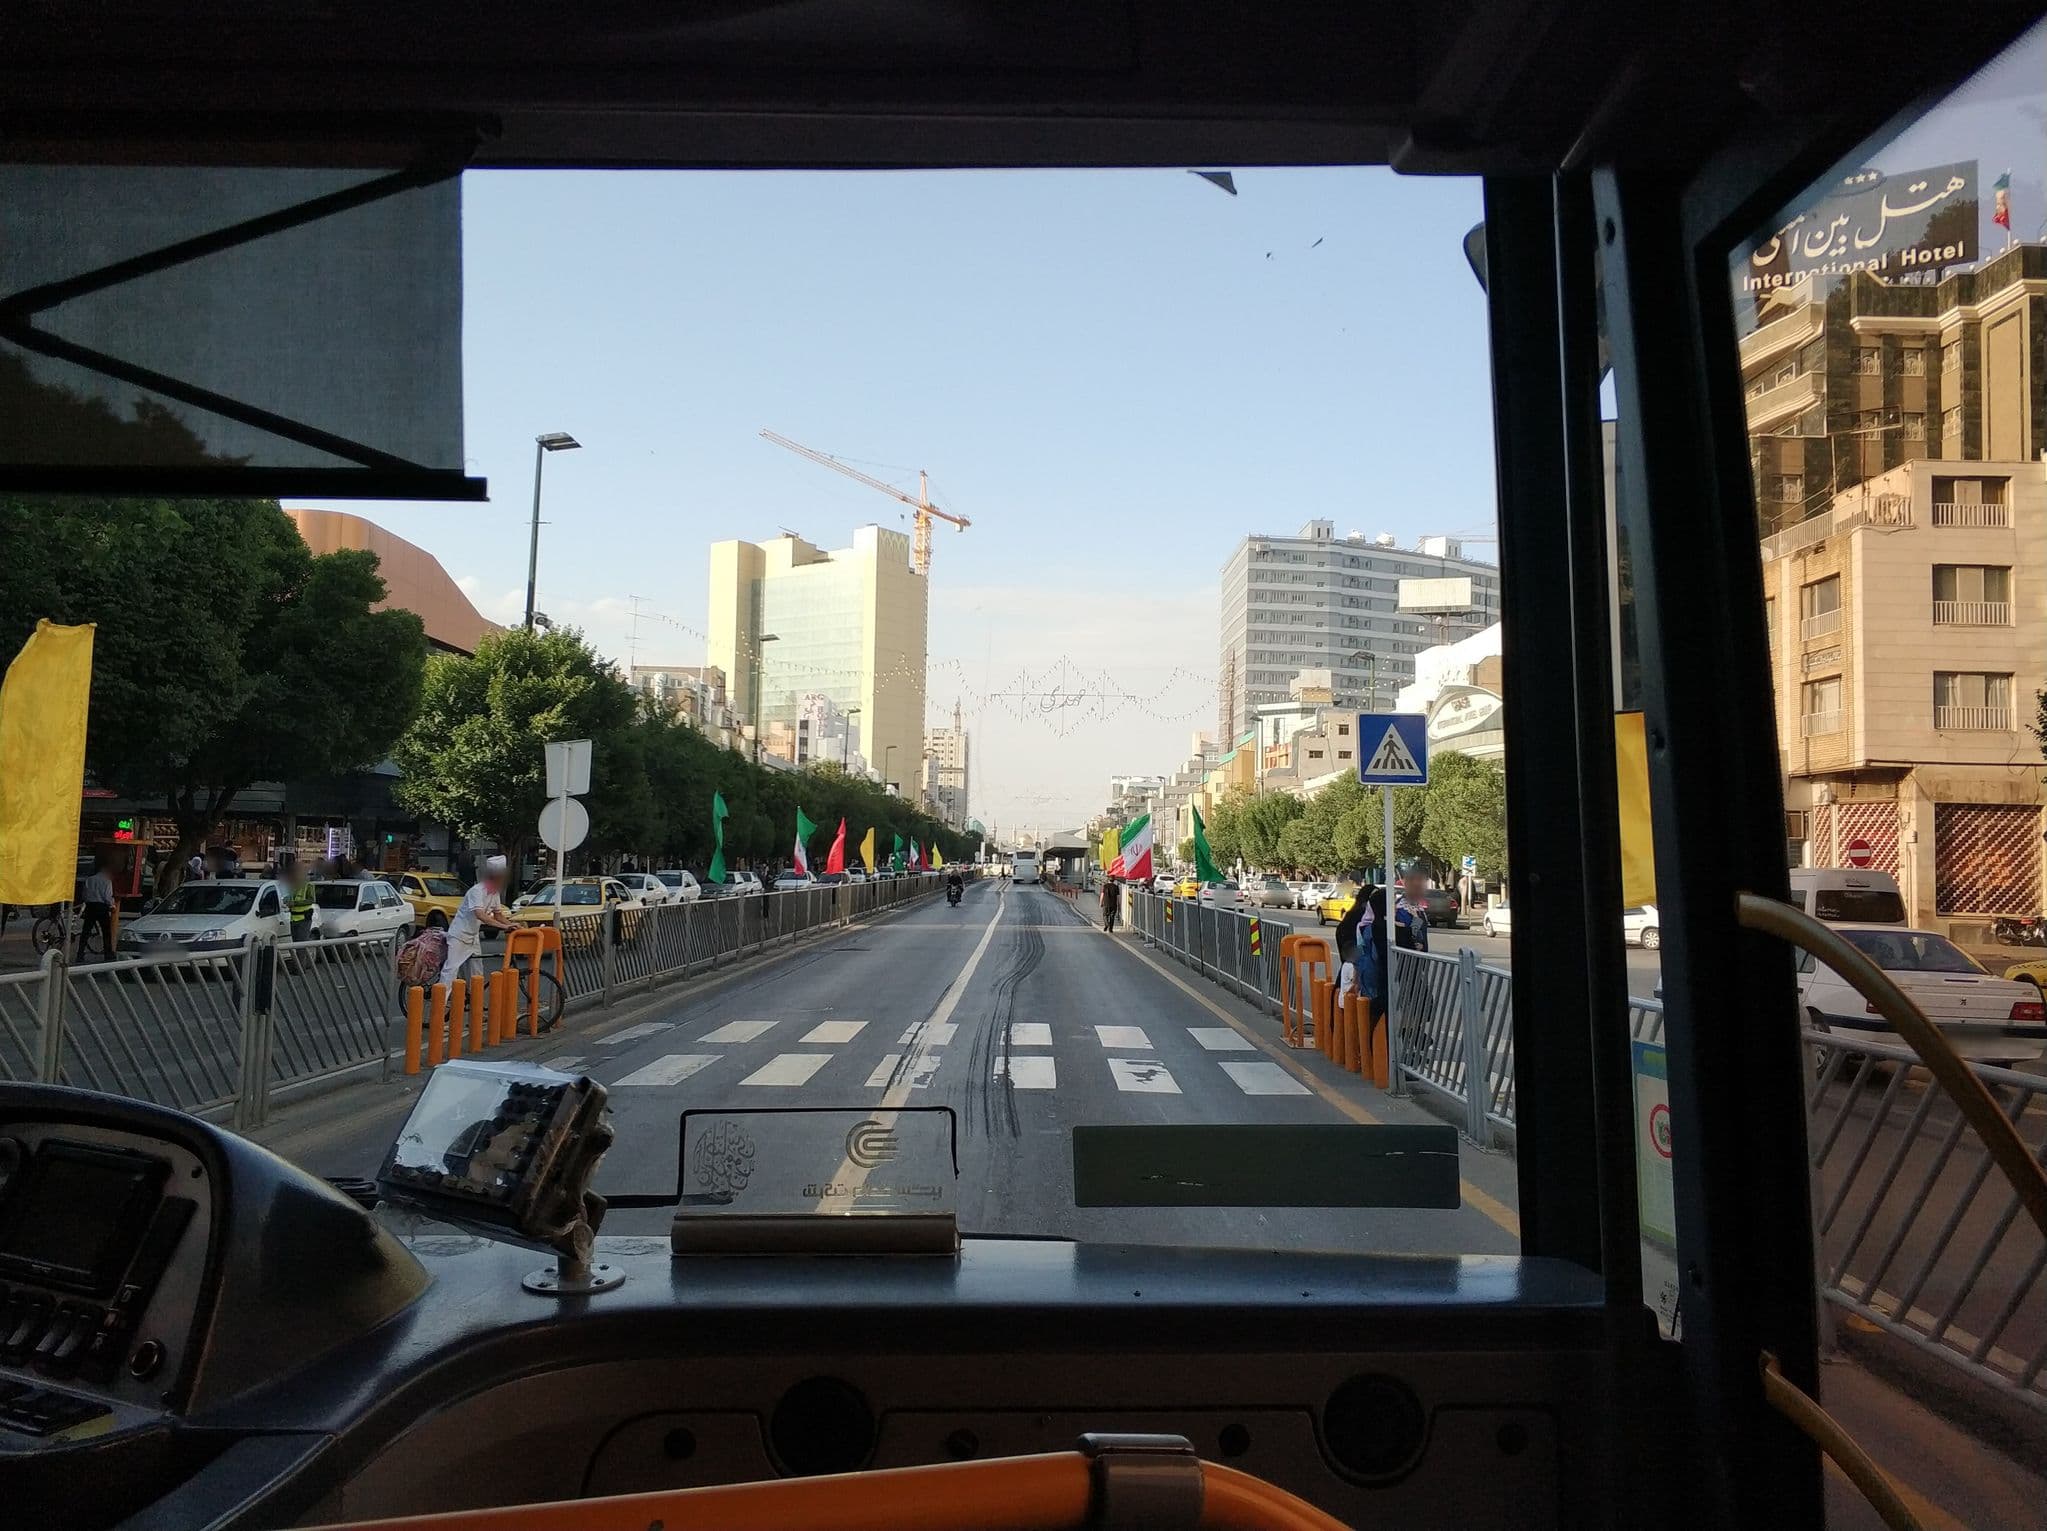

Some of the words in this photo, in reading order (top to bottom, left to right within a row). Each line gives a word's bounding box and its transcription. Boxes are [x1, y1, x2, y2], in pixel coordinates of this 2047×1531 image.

[1854, 175, 1966, 250] هتل
[1803, 213, 1850, 258] بین
[1901, 240, 1965, 267] Hotel
